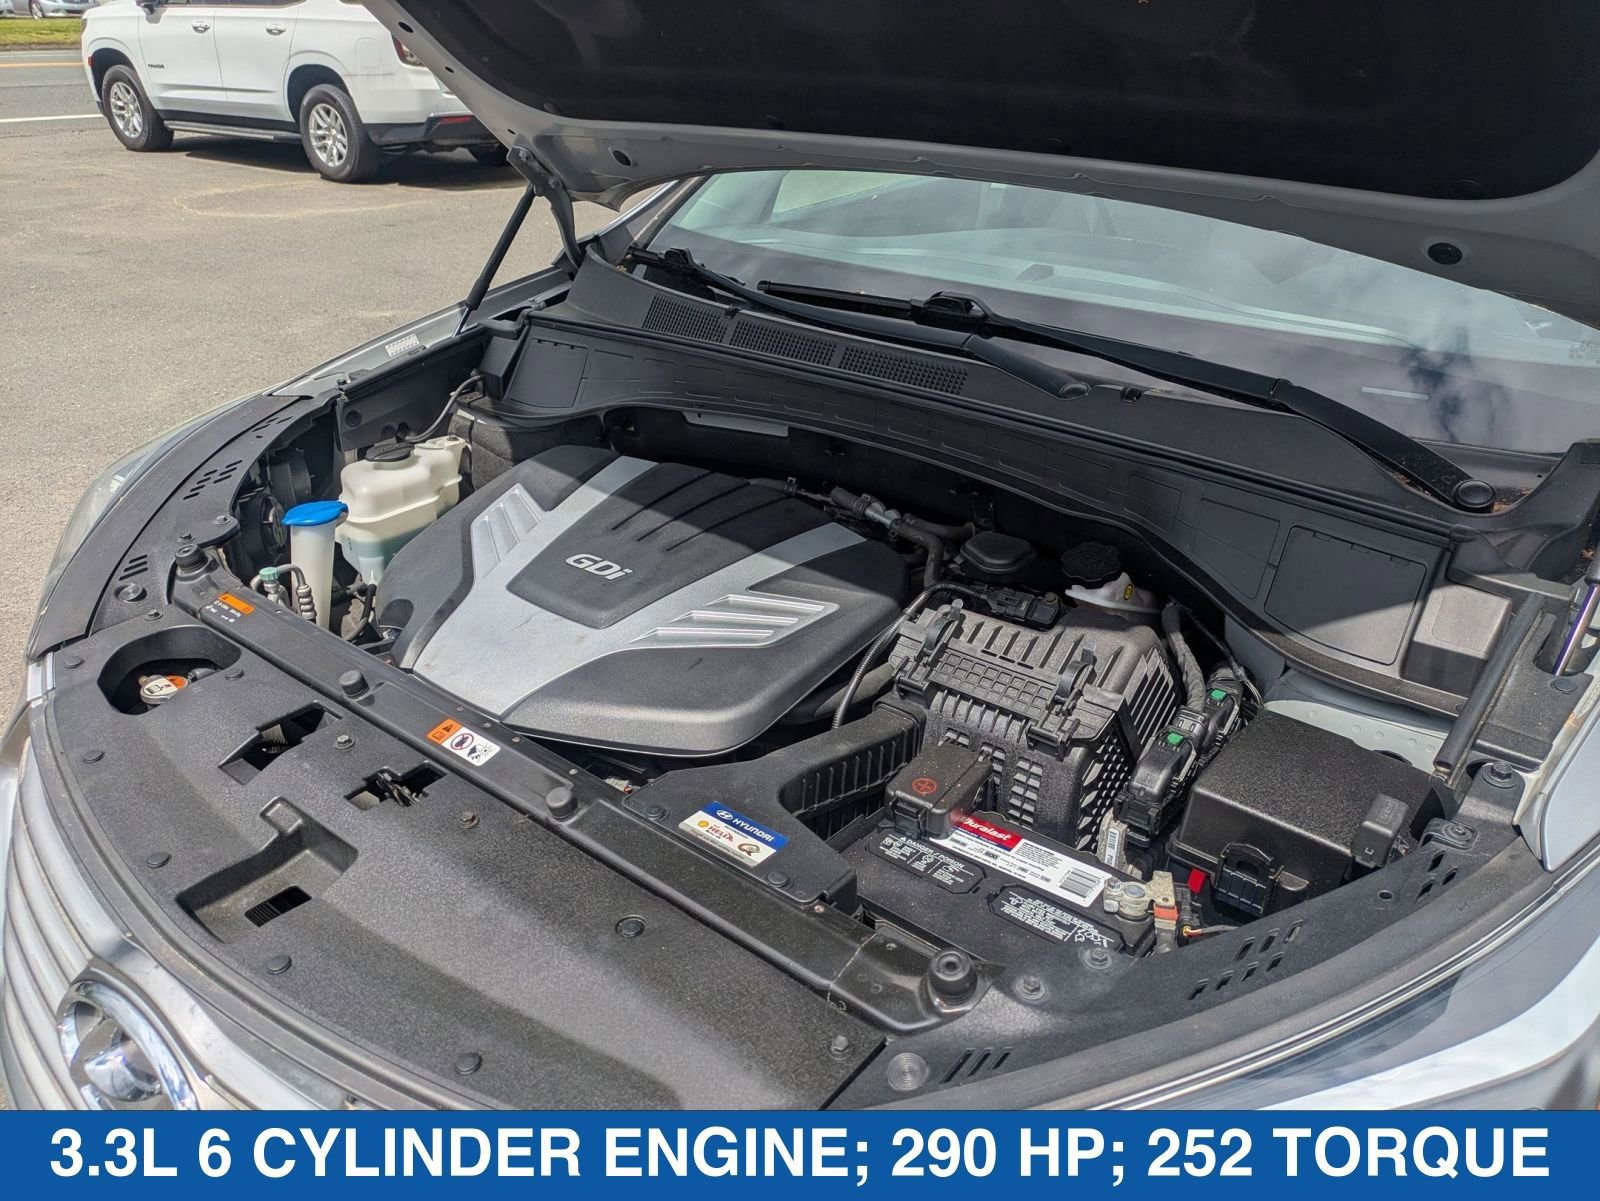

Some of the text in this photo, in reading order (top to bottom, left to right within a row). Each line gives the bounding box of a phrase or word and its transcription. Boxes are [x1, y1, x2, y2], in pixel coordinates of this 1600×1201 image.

[565, 553, 633, 580] GDi
[708, 825, 734, 842] HELIX
[732, 818, 775, 843] HYUNDAI
[906, 838, 934, 856] DANGER
[939, 854, 966, 869] POISON
